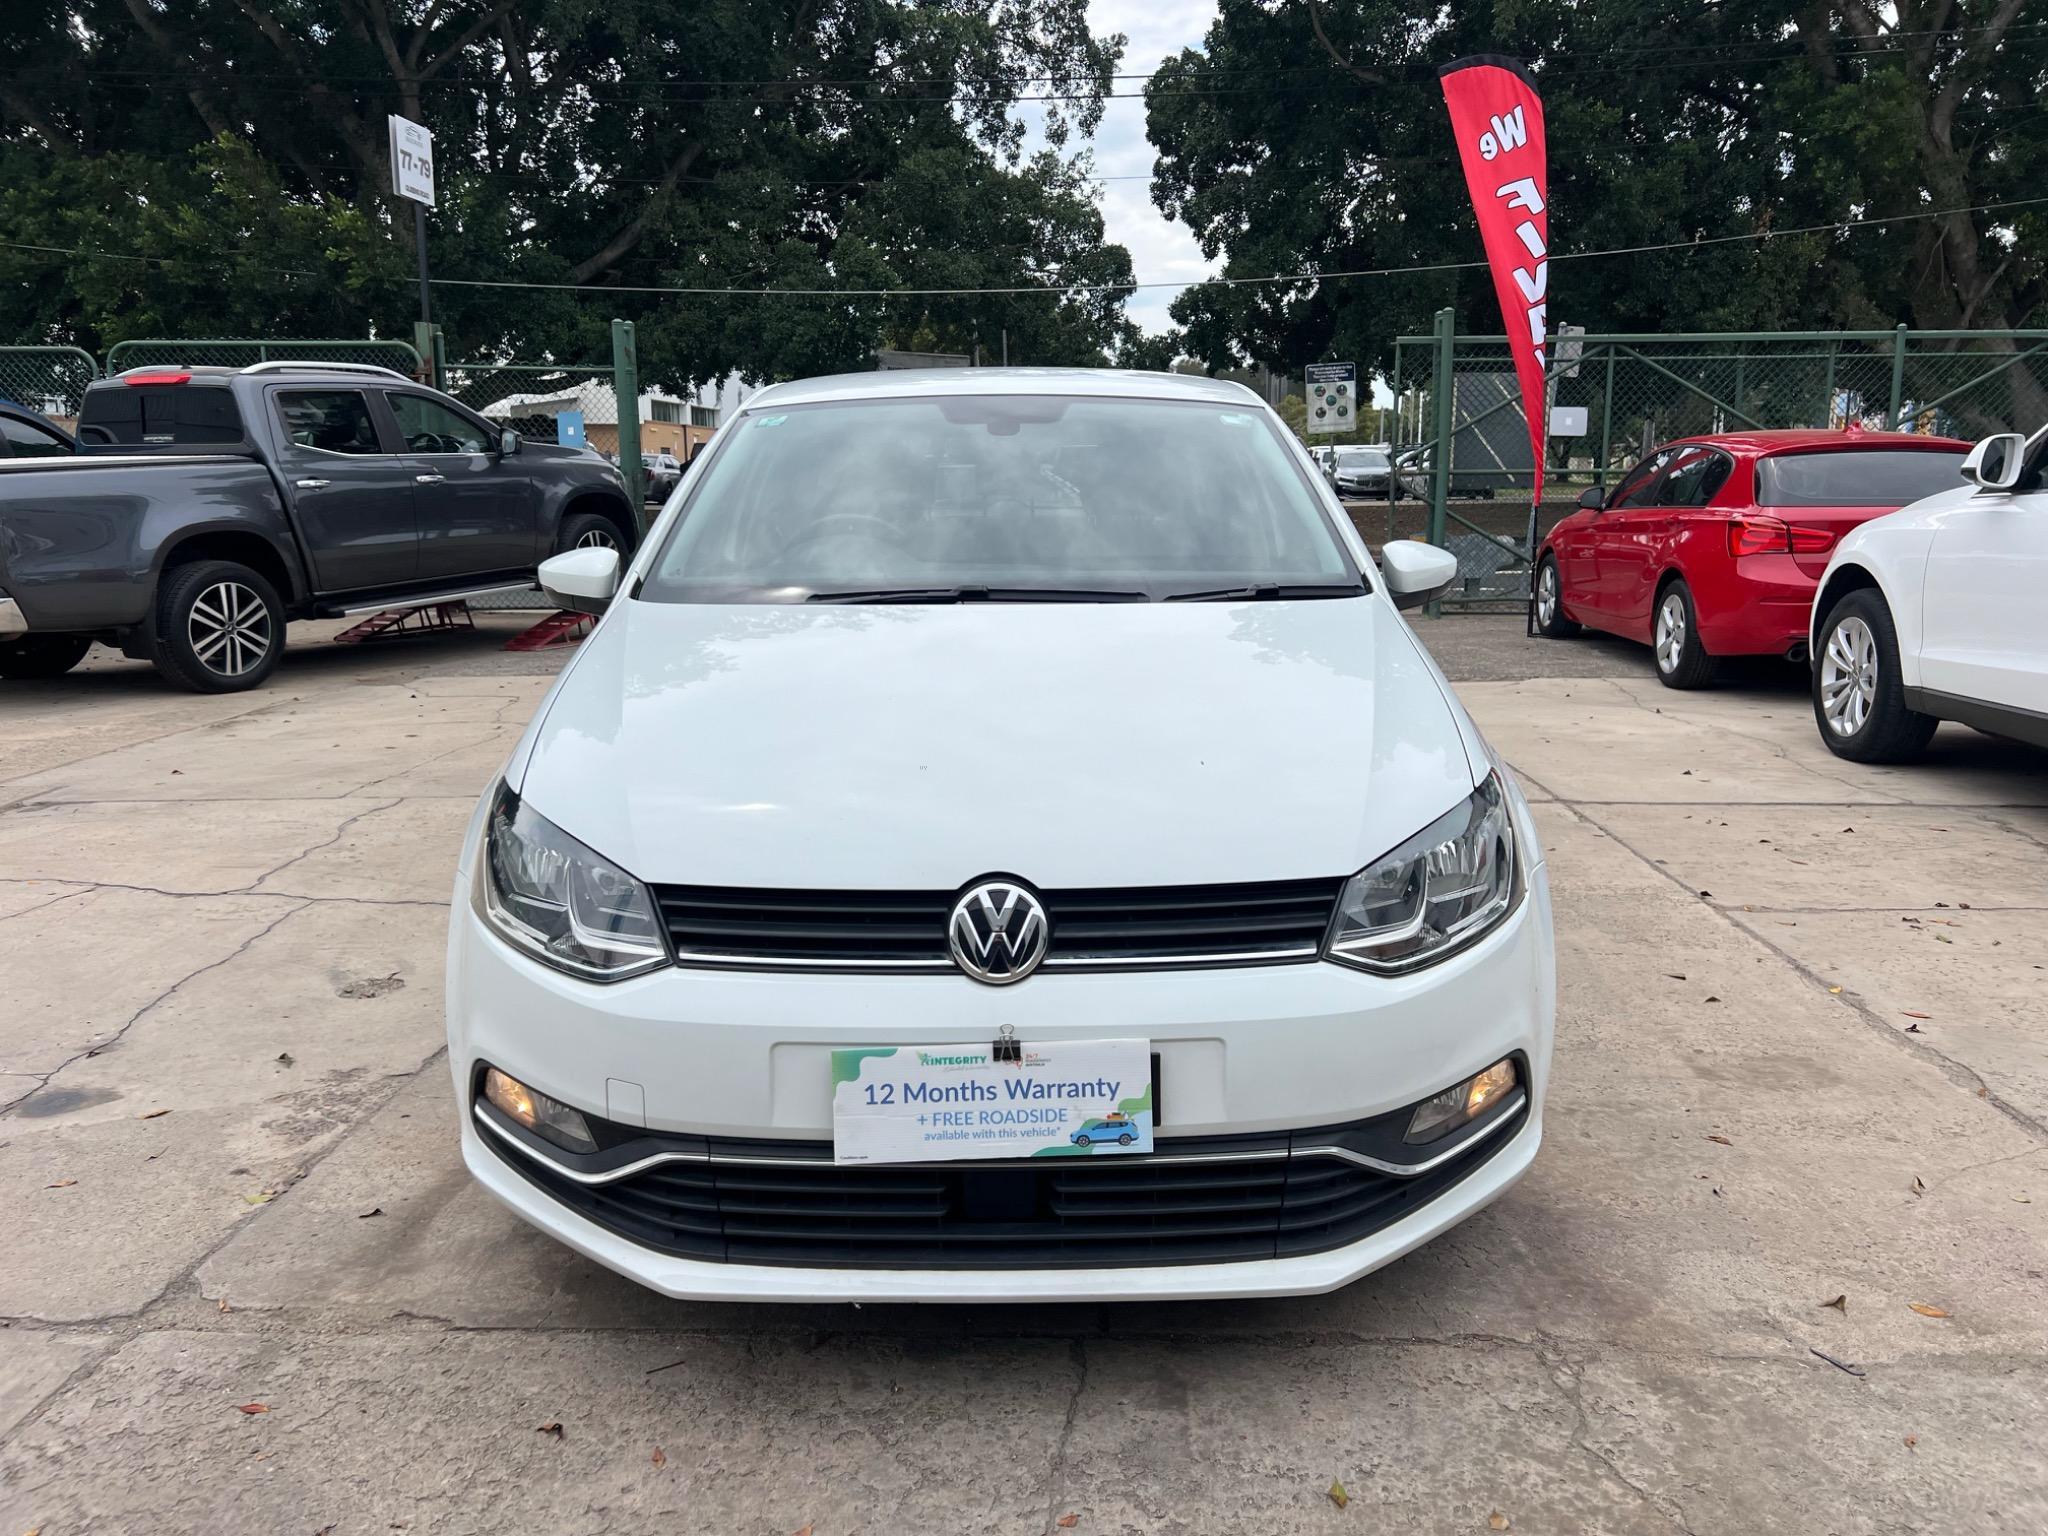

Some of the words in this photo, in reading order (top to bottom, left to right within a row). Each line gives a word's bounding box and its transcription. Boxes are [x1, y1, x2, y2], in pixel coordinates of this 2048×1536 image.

[930, 1055, 988, 1066] INTEGRITY
[864, 1083, 896, 1106] 12
[903, 1080, 998, 1104] Months
[1004, 1078, 1121, 1102] Warranty
[932, 1111, 974, 1127] FREE
[980, 1108, 1069, 1125] ROADSIDE
[924, 1130, 970, 1141] available
[972, 1129, 996, 1139] with
[998, 1127, 1018, 1138] this
